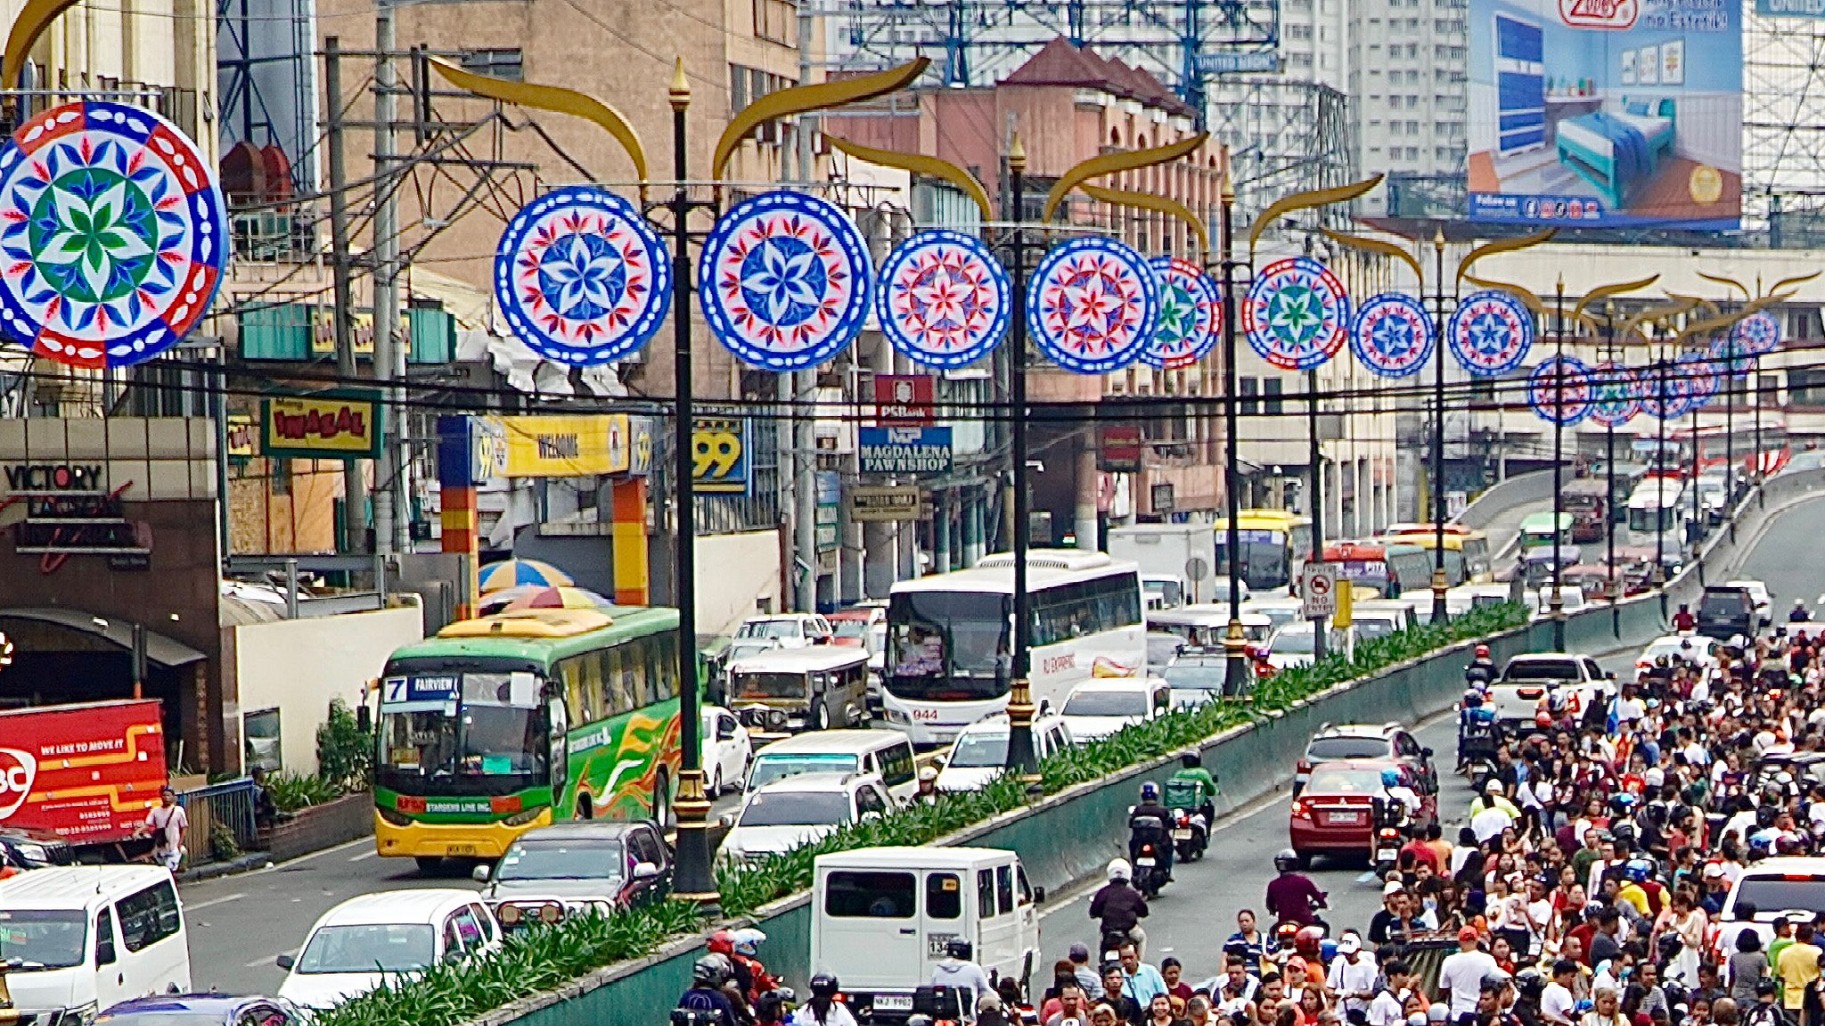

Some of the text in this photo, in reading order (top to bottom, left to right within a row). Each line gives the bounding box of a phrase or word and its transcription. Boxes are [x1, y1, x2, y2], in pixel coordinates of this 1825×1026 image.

[537, 433, 579, 459] WELCOME
[691, 430, 742, 479] 99
[860, 445, 951, 460] MAGDALENA
[864, 459, 948, 472] PAWNSHOP
[4, 465, 102, 491] VICTORY
[387, 680, 404, 699] 7
[414, 677, 453, 691] FAIRVIEW
[913, 708, 938, 721] 944
[41, 738, 124, 755] WE LIKE TO MOVE IT
